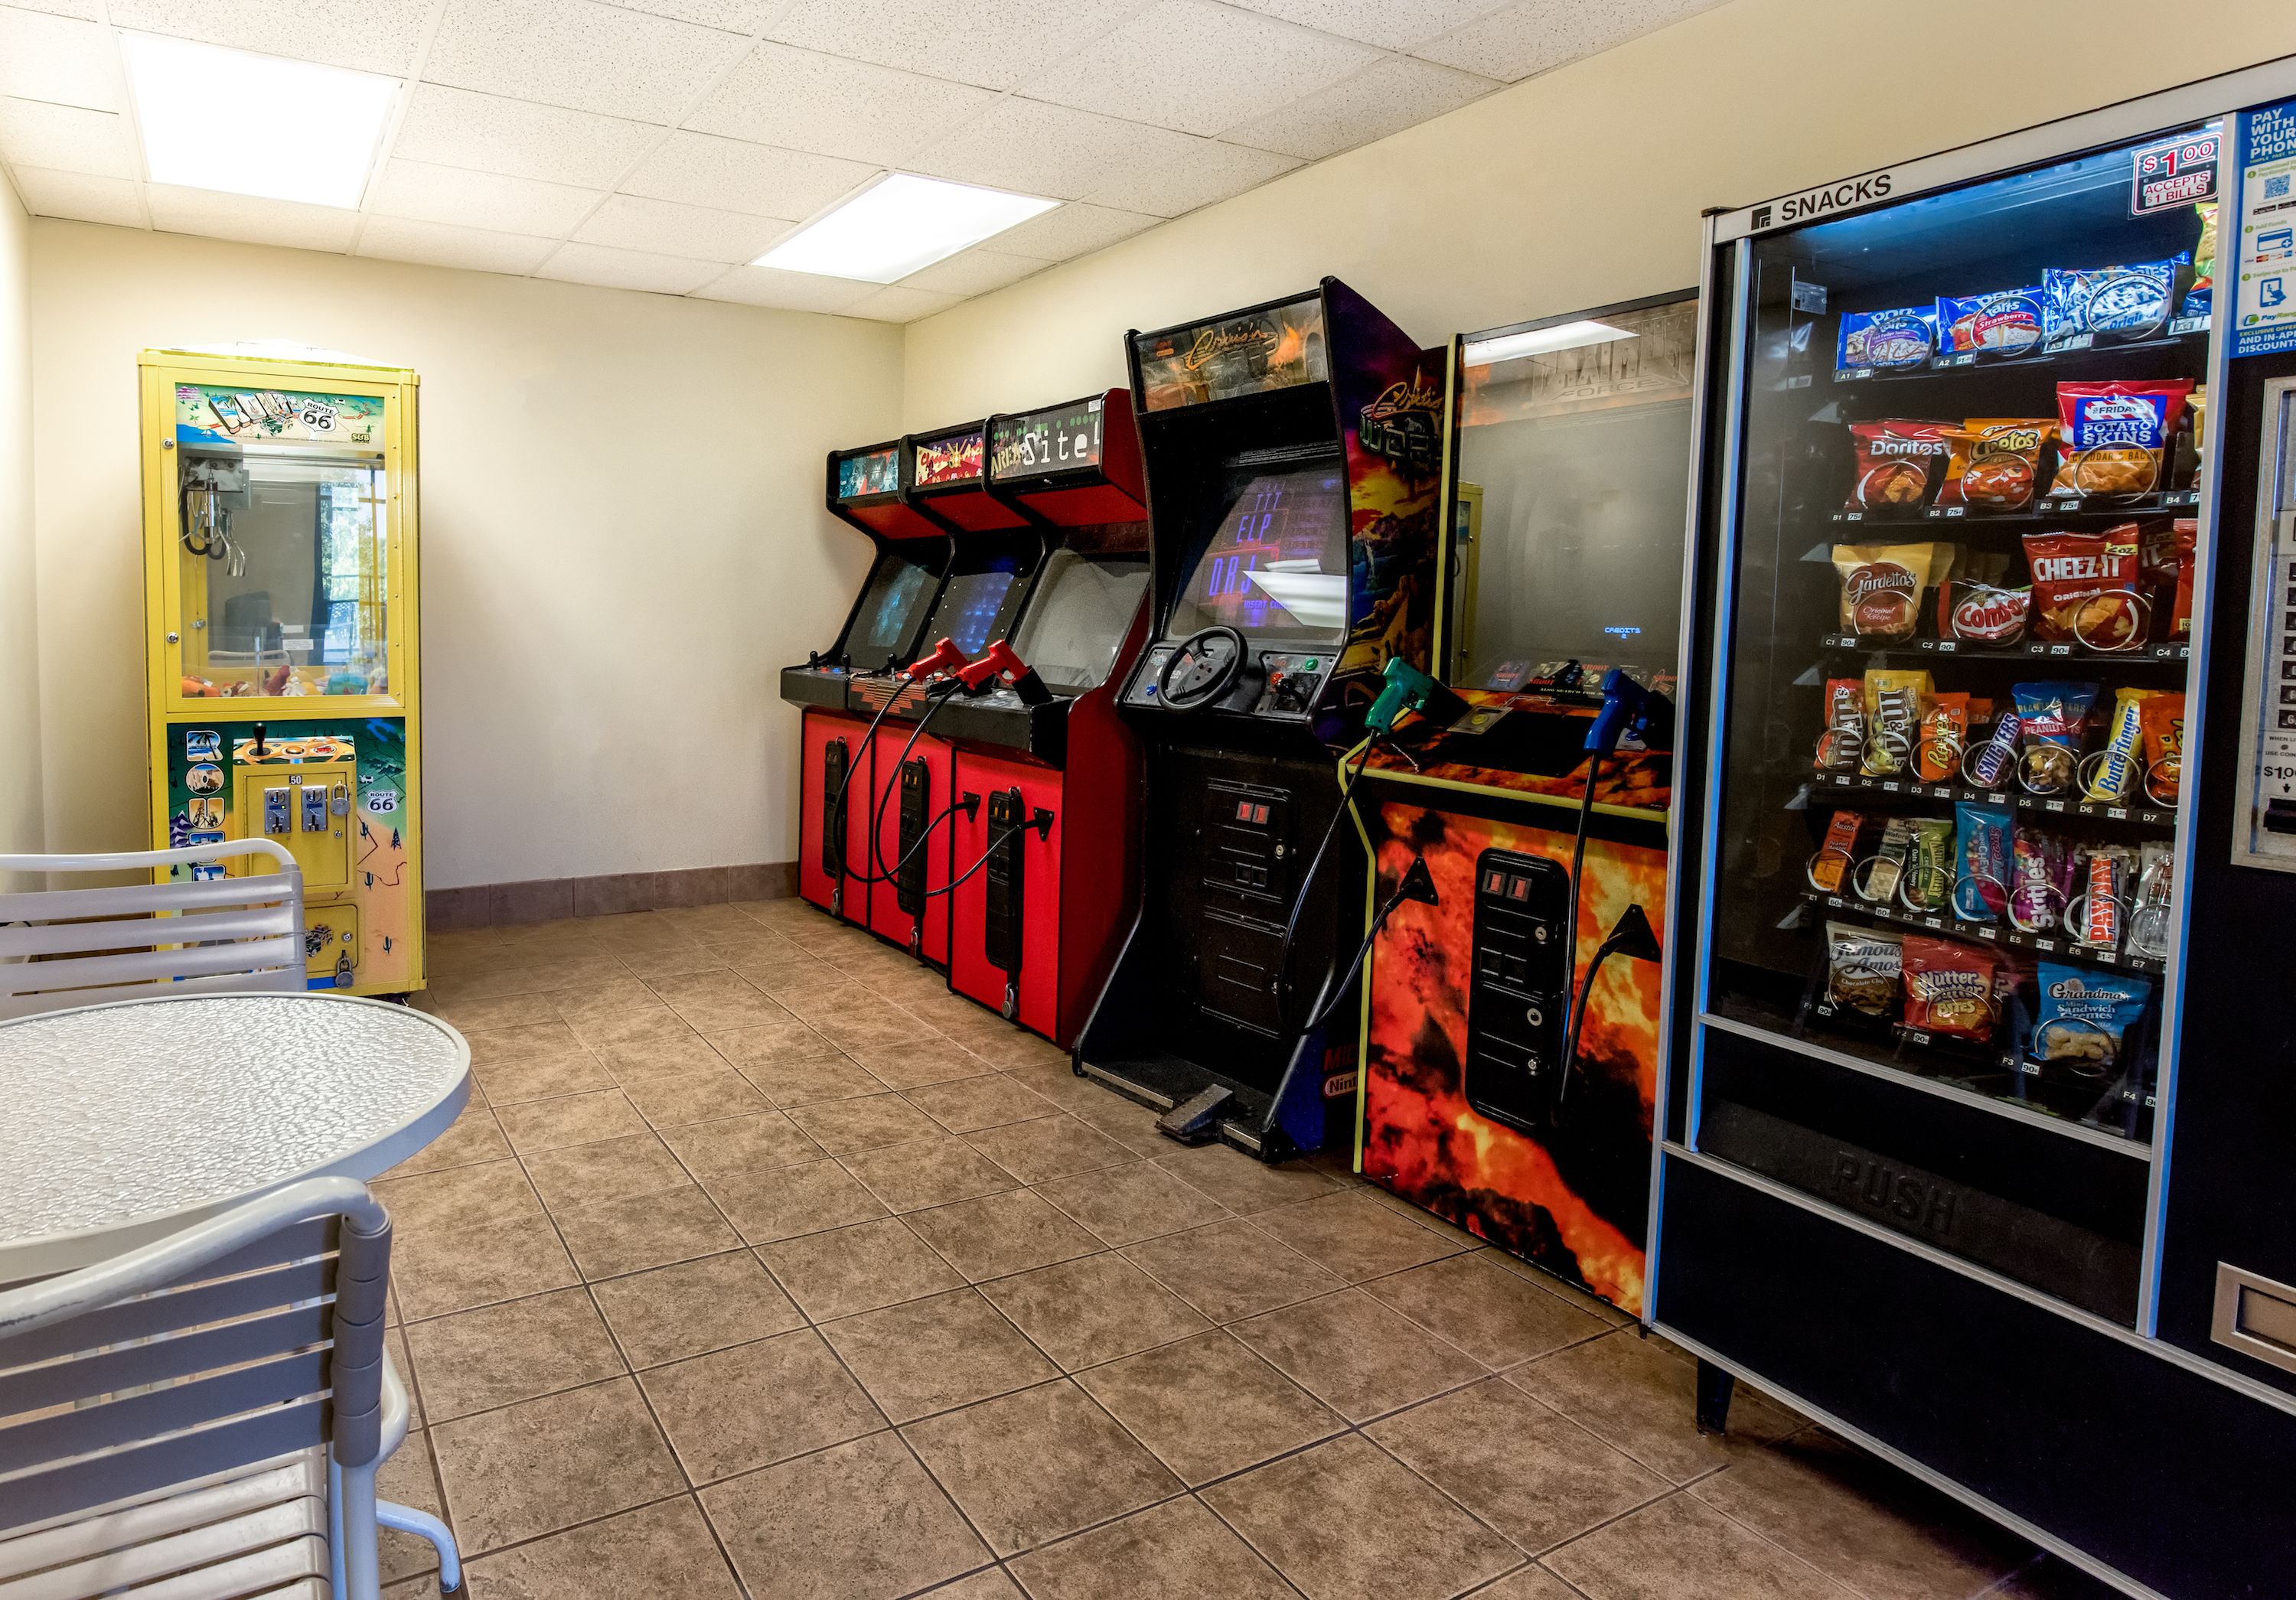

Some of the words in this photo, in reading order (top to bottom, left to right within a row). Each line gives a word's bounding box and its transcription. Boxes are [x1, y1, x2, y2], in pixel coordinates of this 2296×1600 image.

[2252, 108, 2282, 125] PAY
[2251, 116, 2294, 136] WITH
[2251, 127, 2296, 147] YOUR
[2145, 172, 2209, 194] ACCEPTS
[1782, 174, 1891, 221] SNACKS
[2148, 194, 2160, 204] $1
[2166, 184, 2205, 200] BILLS
[1986, 301, 2020, 316] tarts
[1979, 313, 2027, 329] Strawberry
[2179, 321, 2193, 330] A4
[2239, 336, 2262, 345] AND
[1552, 378, 1666, 401] FORCE
[307, 402, 334, 415] ROUTE
[303, 411, 331, 429] 66
[2083, 422, 2154, 434] POTATO
[2083, 430, 2152, 445] SKINS
[1023, 430, 1088, 466] Site
[1870, 441, 1944, 456] Doritos
[1845, 571, 1916, 605] Gardetto's
[1244, 599, 1267, 609] INSERT
[1976, 712, 2021, 782] SNICKERS
[2098, 706, 2141, 794] Butterfinger
[2264, 766, 2296, 780] $1.0
[370, 797, 395, 811] 66
[1835, 822, 1856, 833] Austin
[1886, 830, 1910, 839] Wafers
[1978, 846, 1989, 875] CHEW
[1929, 868, 1944, 895] ALLEY
[2025, 857, 2055, 928] Skittles
[2089, 858, 2115, 942] PAYDAY
[2009, 935, 2021, 943] E5
[2069, 947, 2082, 955] E6
[1844, 957, 1903, 973] Amos
[2132, 960, 2145, 968] E7
[1841, 978, 1870, 986] Chocolate
[1919, 970, 1978, 988] Nutter
[1936, 1000, 1976, 1015] BITES
[2056, 1003, 2115, 1014] Sandwich
[2060, 1012, 2113, 1020] Cremes
[2123, 1091, 2136, 1100] F4
[1837, 1150, 1956, 1236] PUSH
